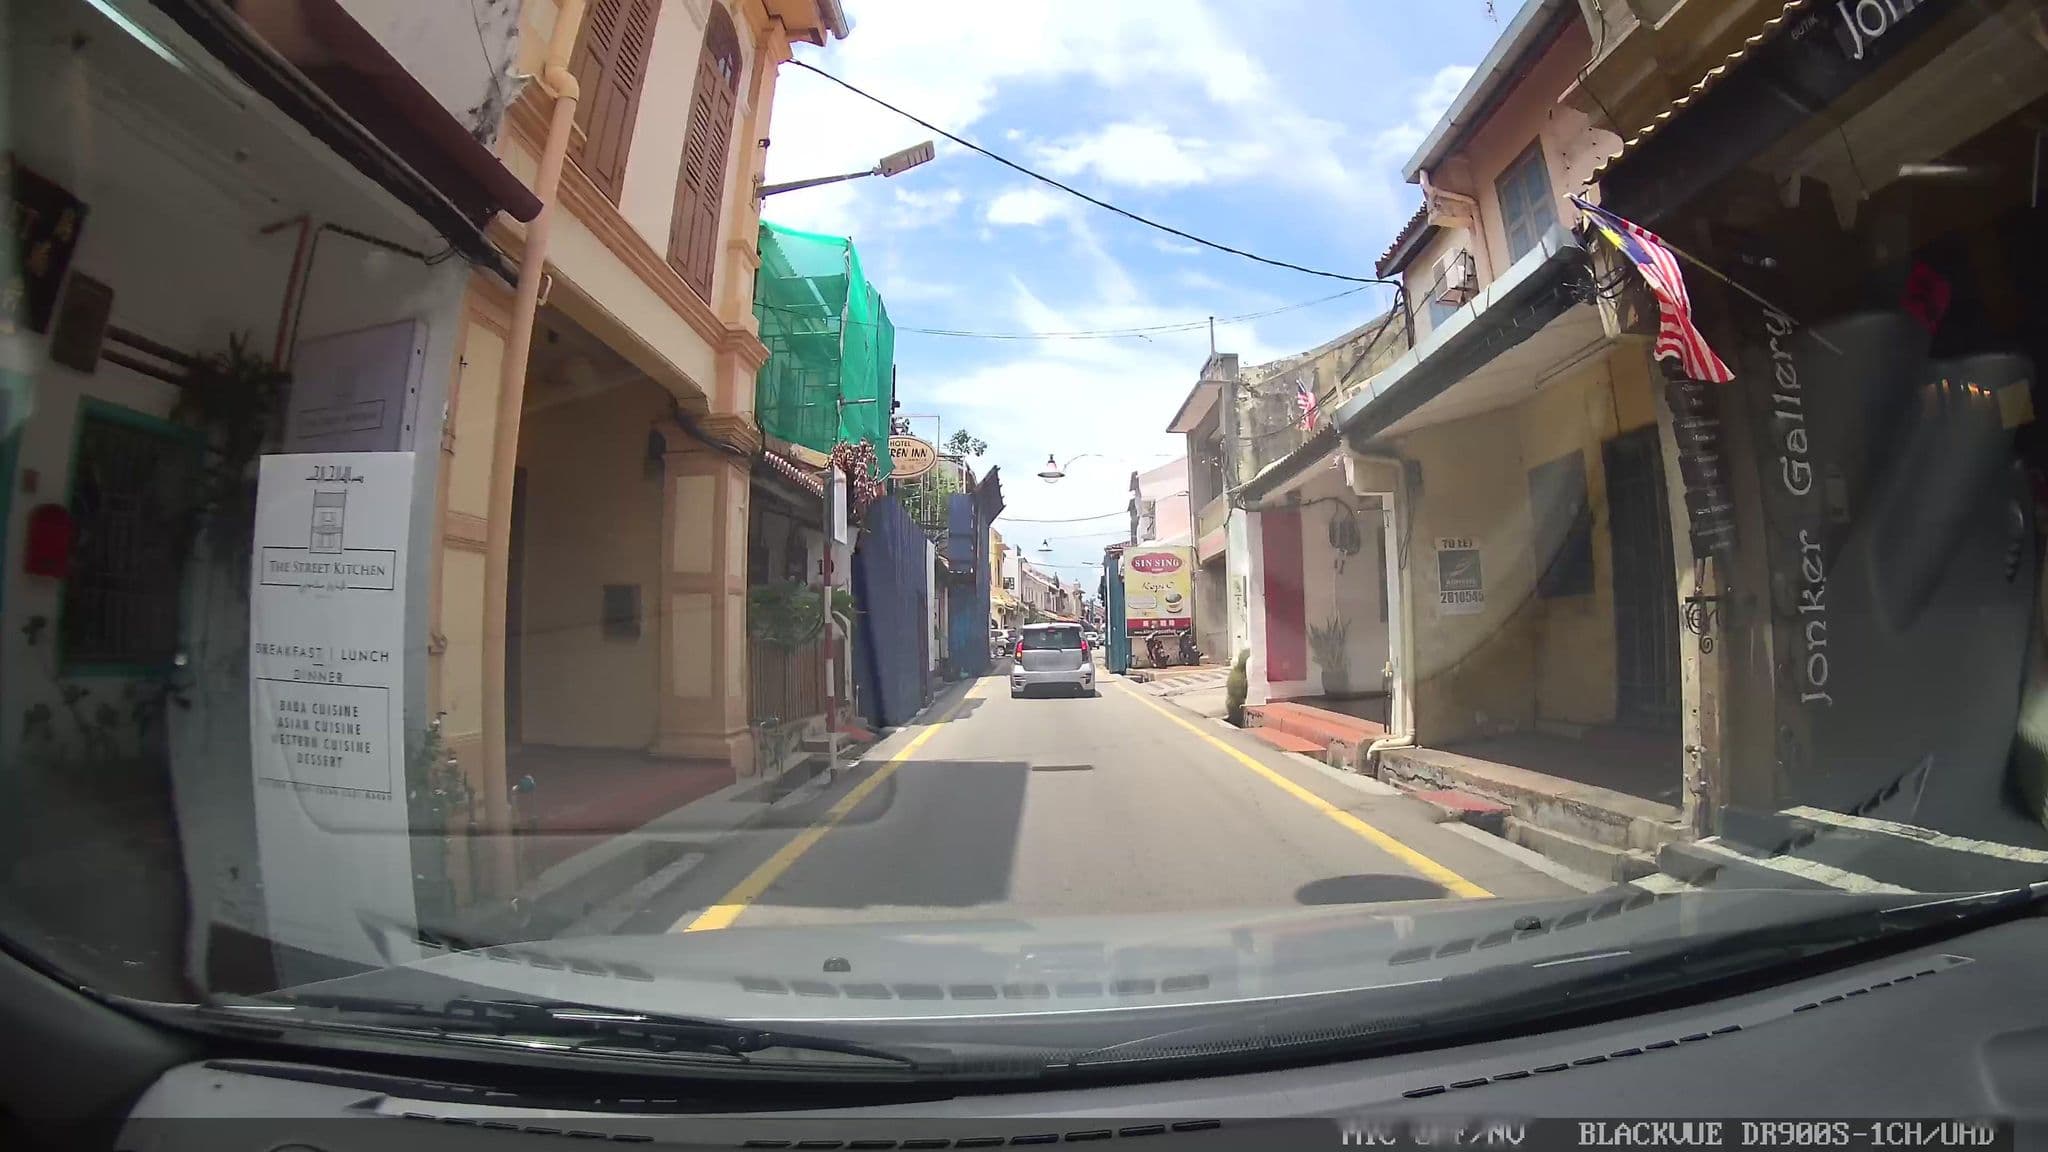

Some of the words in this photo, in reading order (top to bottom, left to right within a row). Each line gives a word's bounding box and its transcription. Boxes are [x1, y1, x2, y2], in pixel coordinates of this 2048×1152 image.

[1762, 309, 1812, 495] Gallery
[911, 447, 928, 458] INN
[269, 560, 290, 573] THE
[293, 561, 330, 574] STREET
[334, 562, 385, 576] KITCHEN
[1134, 559, 1153, 567] SIN
[1154, 559, 1180, 567] SING
[1797, 529, 1832, 706] Jonker
[255, 643, 322, 659] BREAKFAST
[341, 650, 390, 662] LUNCH
[293, 669, 343, 683] DINNER
[312, 703, 358, 718] CUISINE
[277, 717, 309, 731] ASIAN
[314, 720, 361, 735] CUISINE
[323, 738, 370, 754] CUISINE
[296, 752, 343, 768] DESSERT
